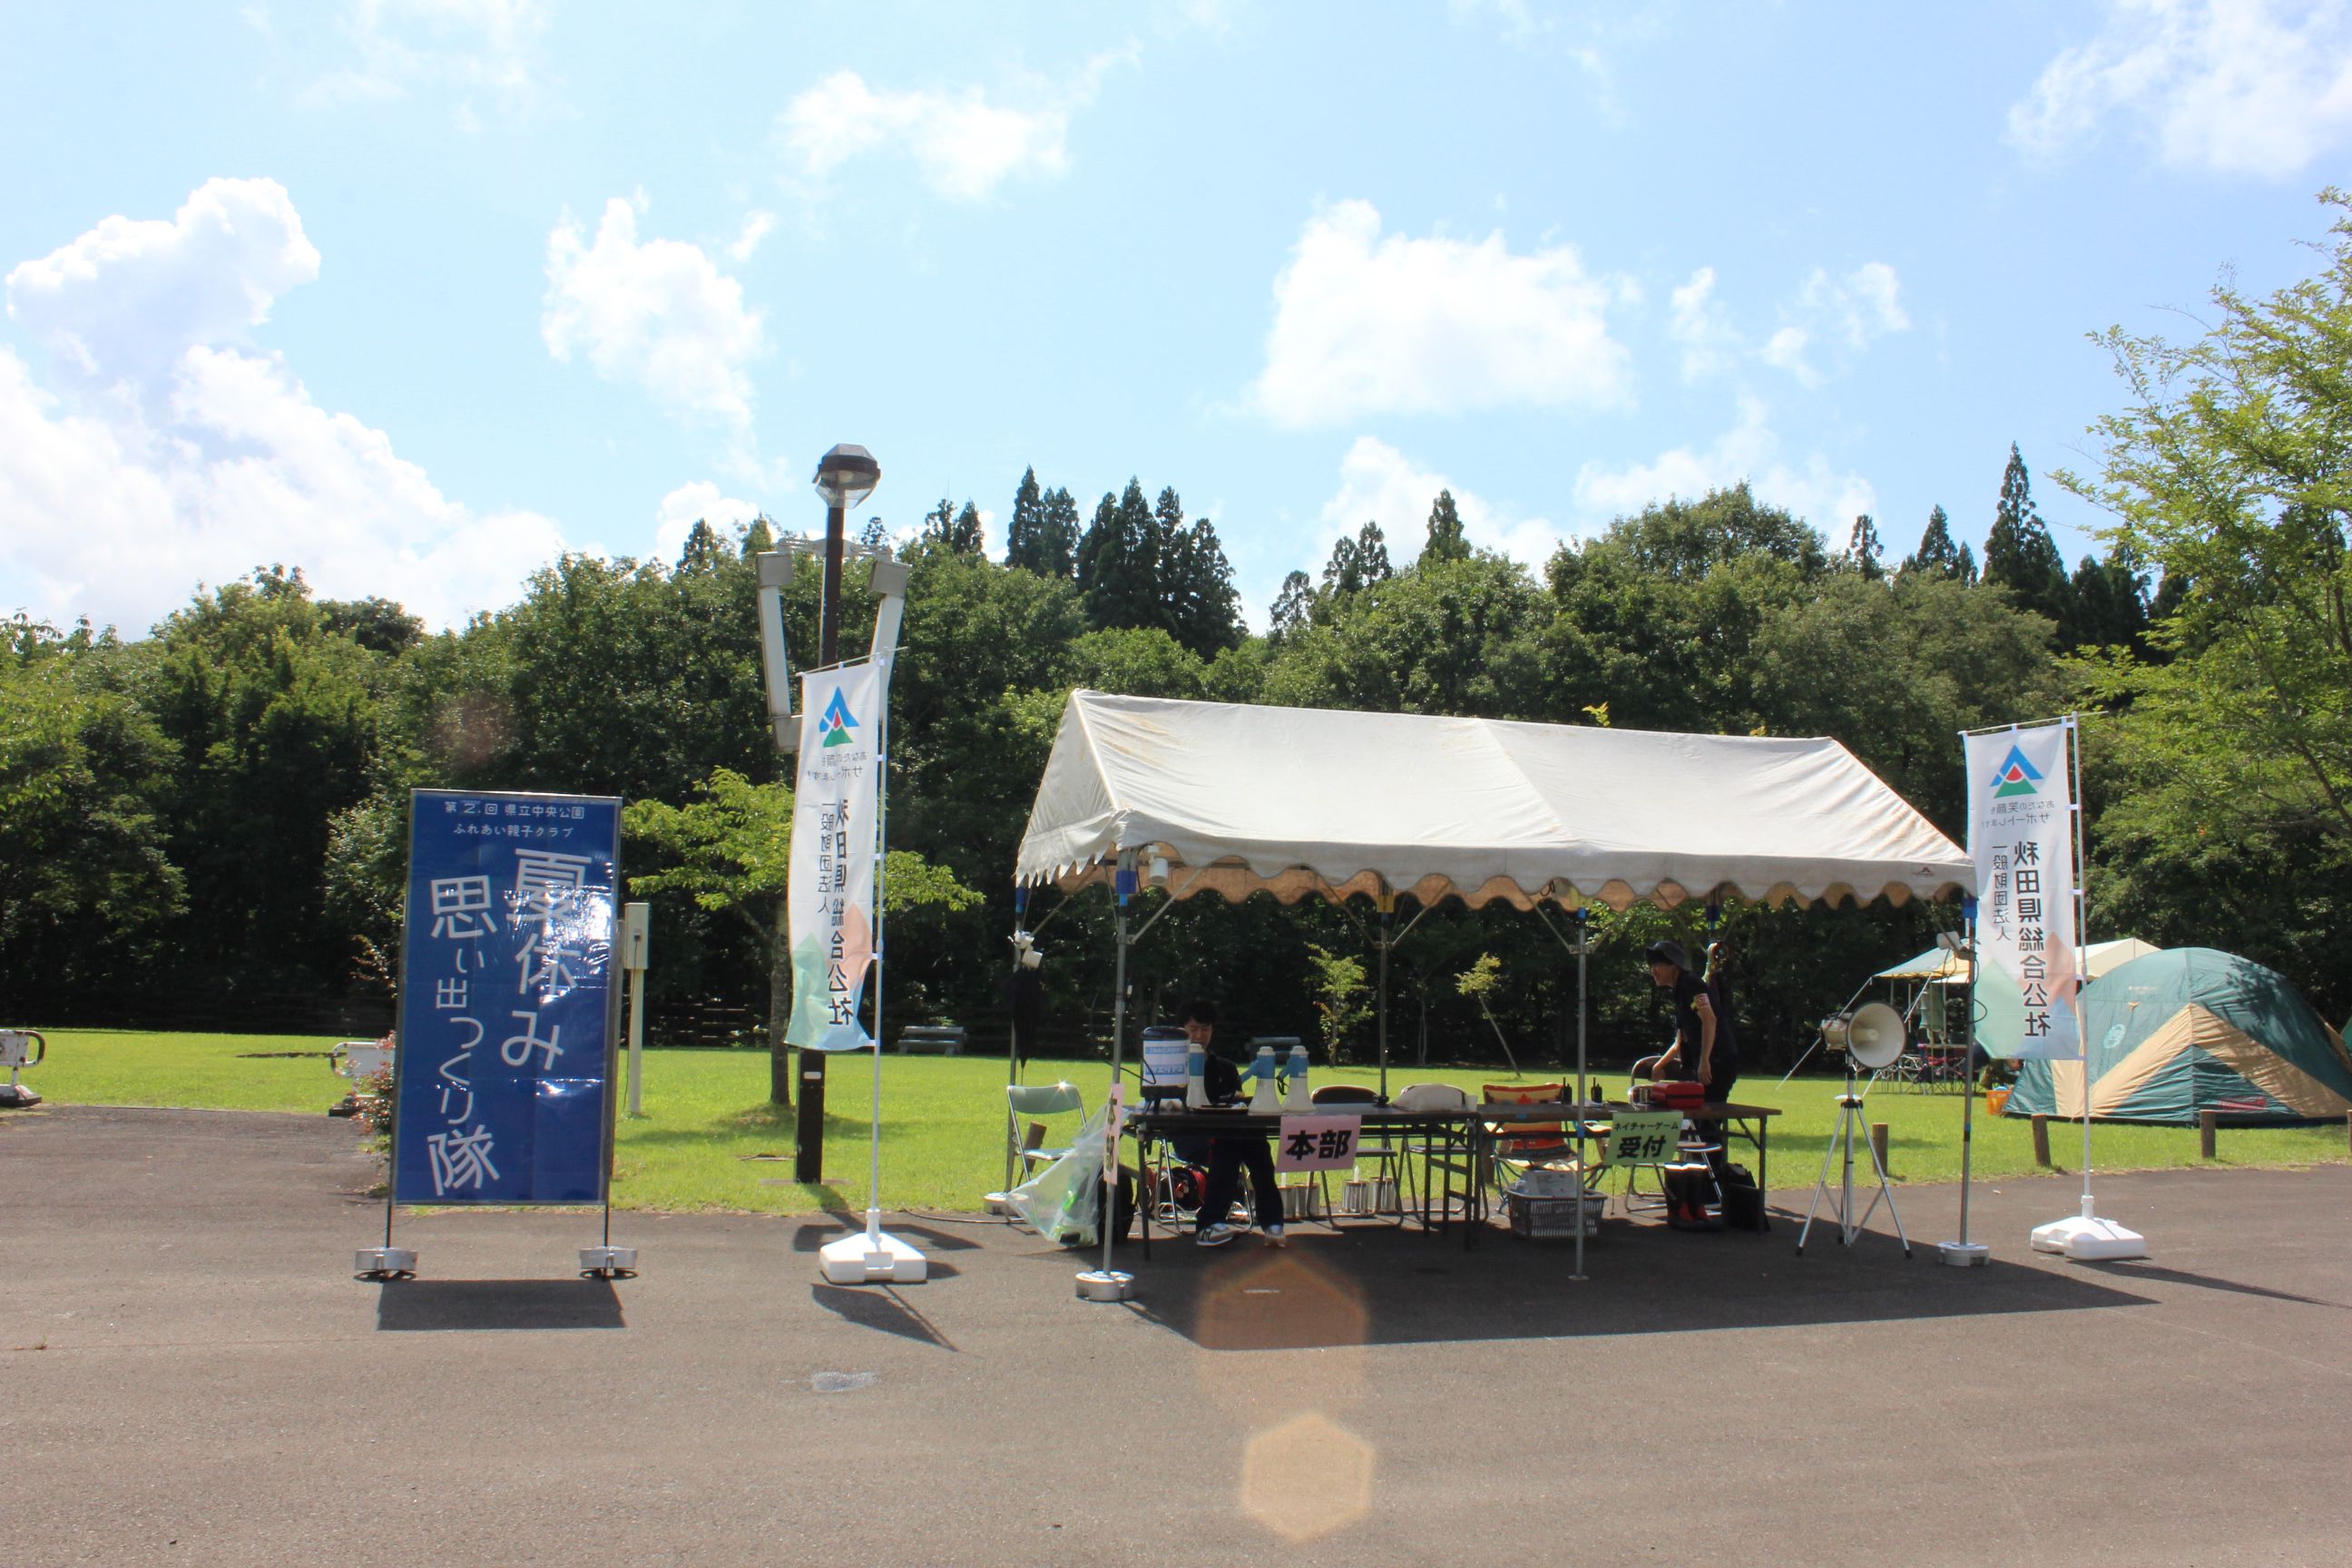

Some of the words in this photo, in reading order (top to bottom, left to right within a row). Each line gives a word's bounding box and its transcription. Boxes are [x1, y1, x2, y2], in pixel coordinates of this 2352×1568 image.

[505, 803, 585, 819] 県立中央公園
[453, 823, 573, 838] ふれあい親子クラブ
[501, 848, 593, 1071] 夏休み
[426, 874, 500, 1196] 思い出つくり隊
[1613, 1121, 1680, 1132] ネイチャーゲーム
[1285, 1129, 1353, 1161] 本部
[1617, 1134, 1667, 1159] 受付
